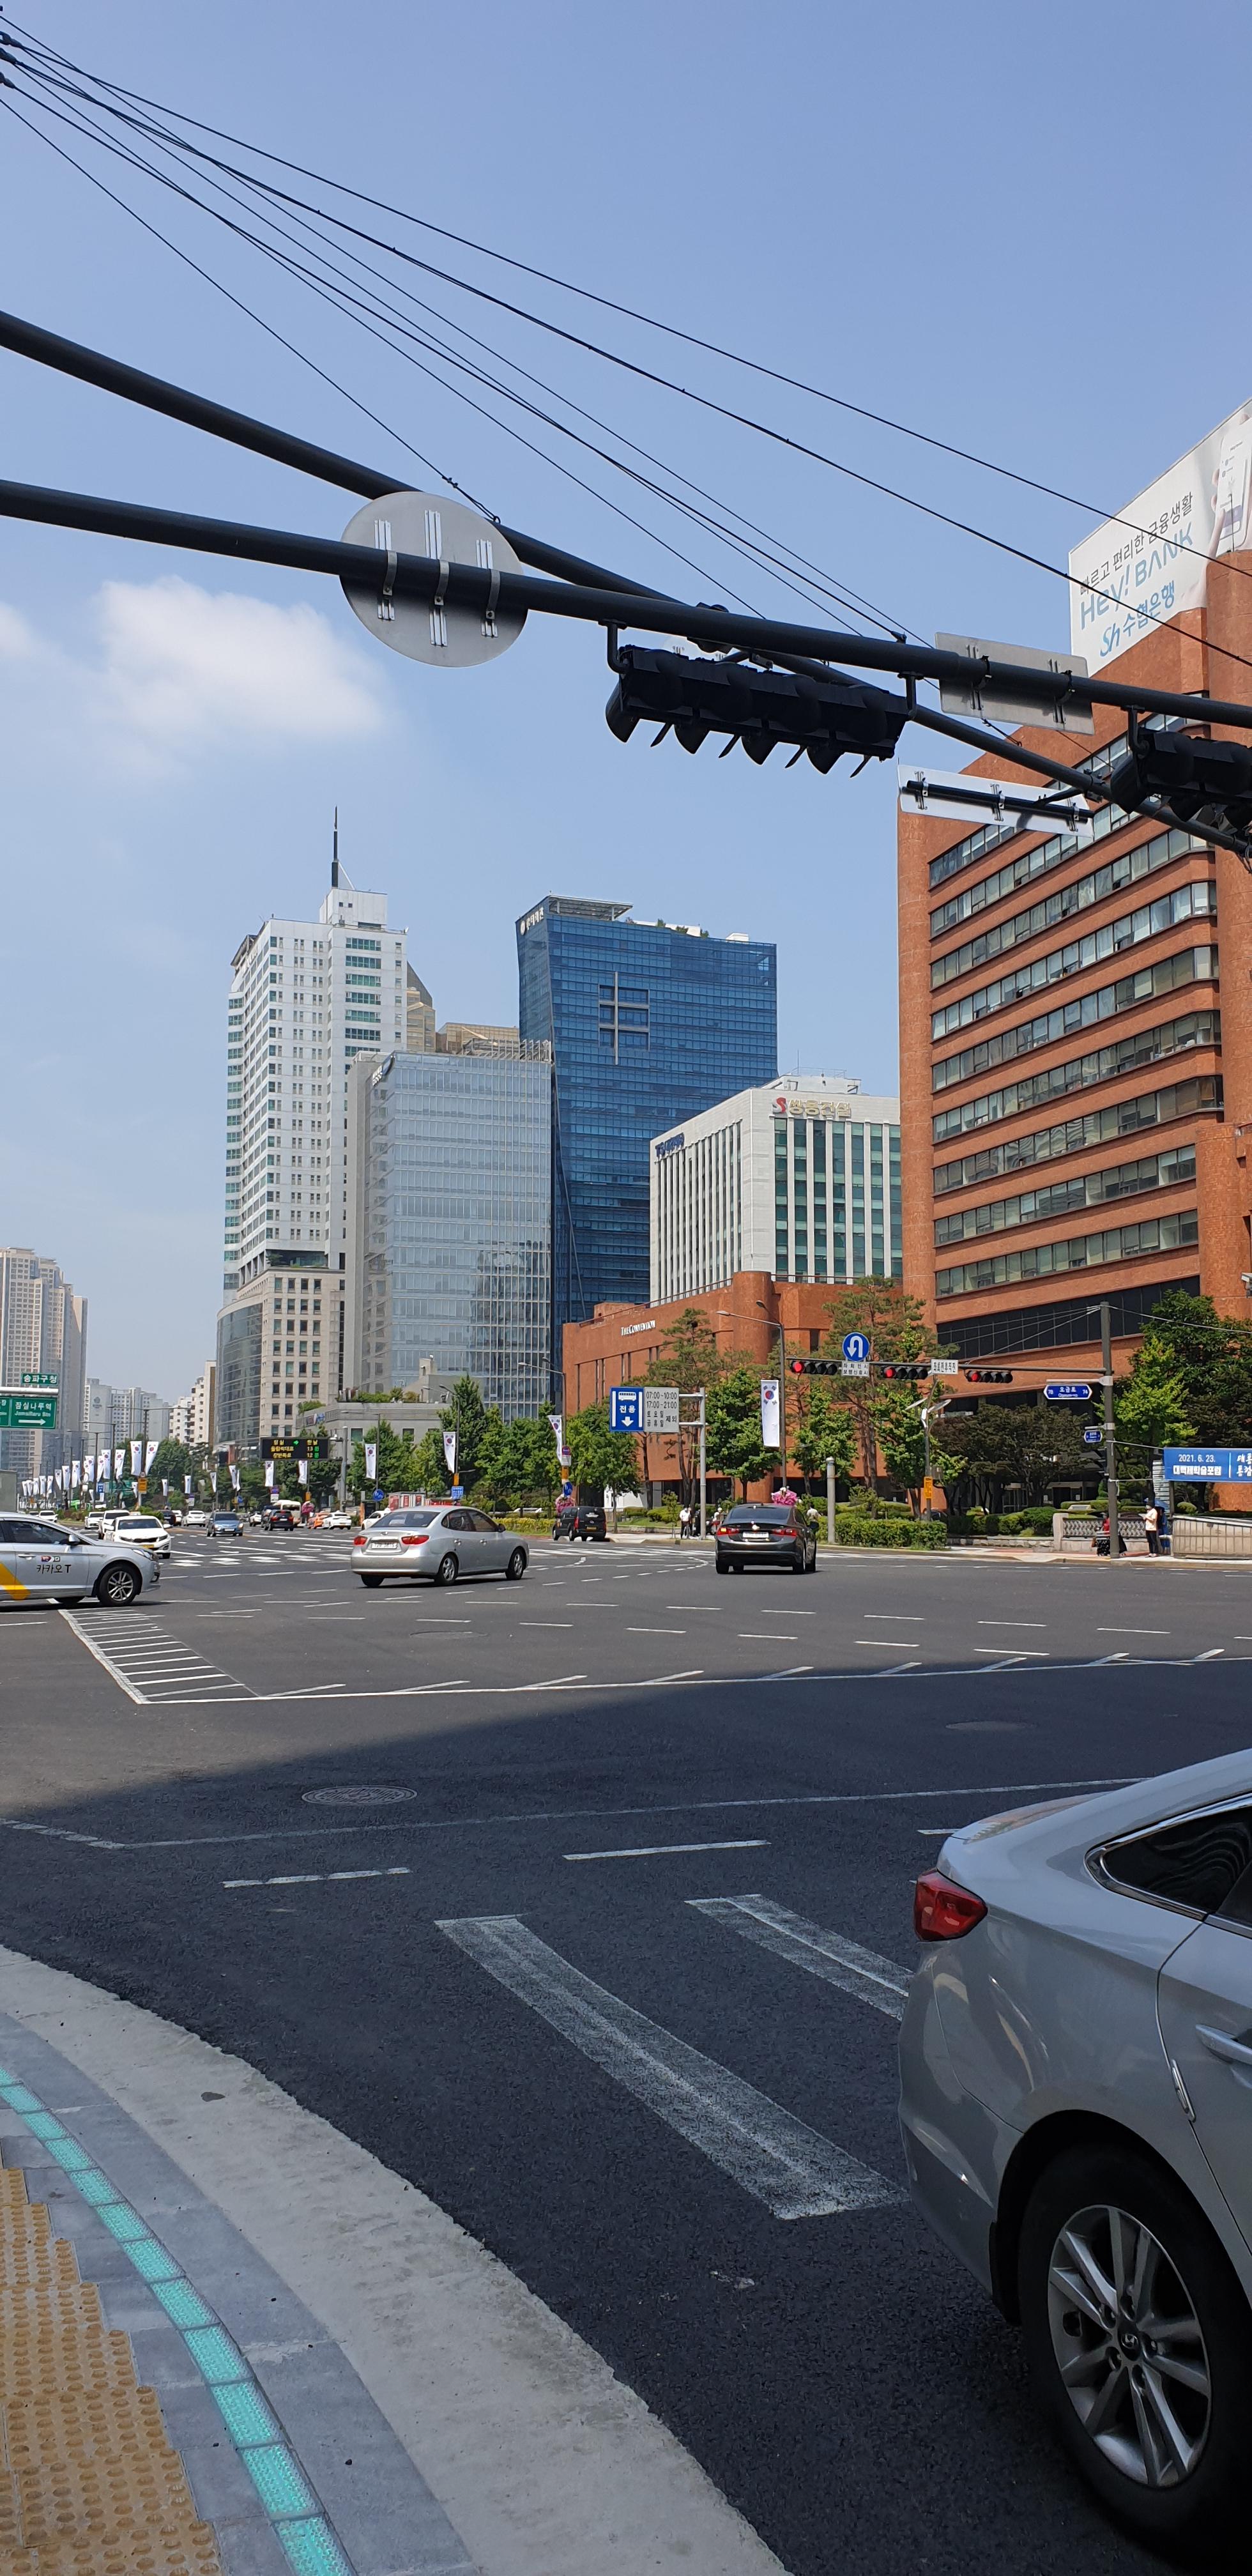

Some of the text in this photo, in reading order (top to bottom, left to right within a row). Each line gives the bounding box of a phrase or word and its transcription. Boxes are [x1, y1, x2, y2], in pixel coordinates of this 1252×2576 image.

[1080, 491, 1193, 595] 빠르고 편리한 금융생활
[1135, 521, 1193, 587] BANK
[788, 1099, 851, 1117] 쌍용건설
[24, 1374, 57, 1384] 송파구청
[15, 1402, 52, 1411] 잠실나루역
[36, 1564, 72, 1574] 카카오 T
